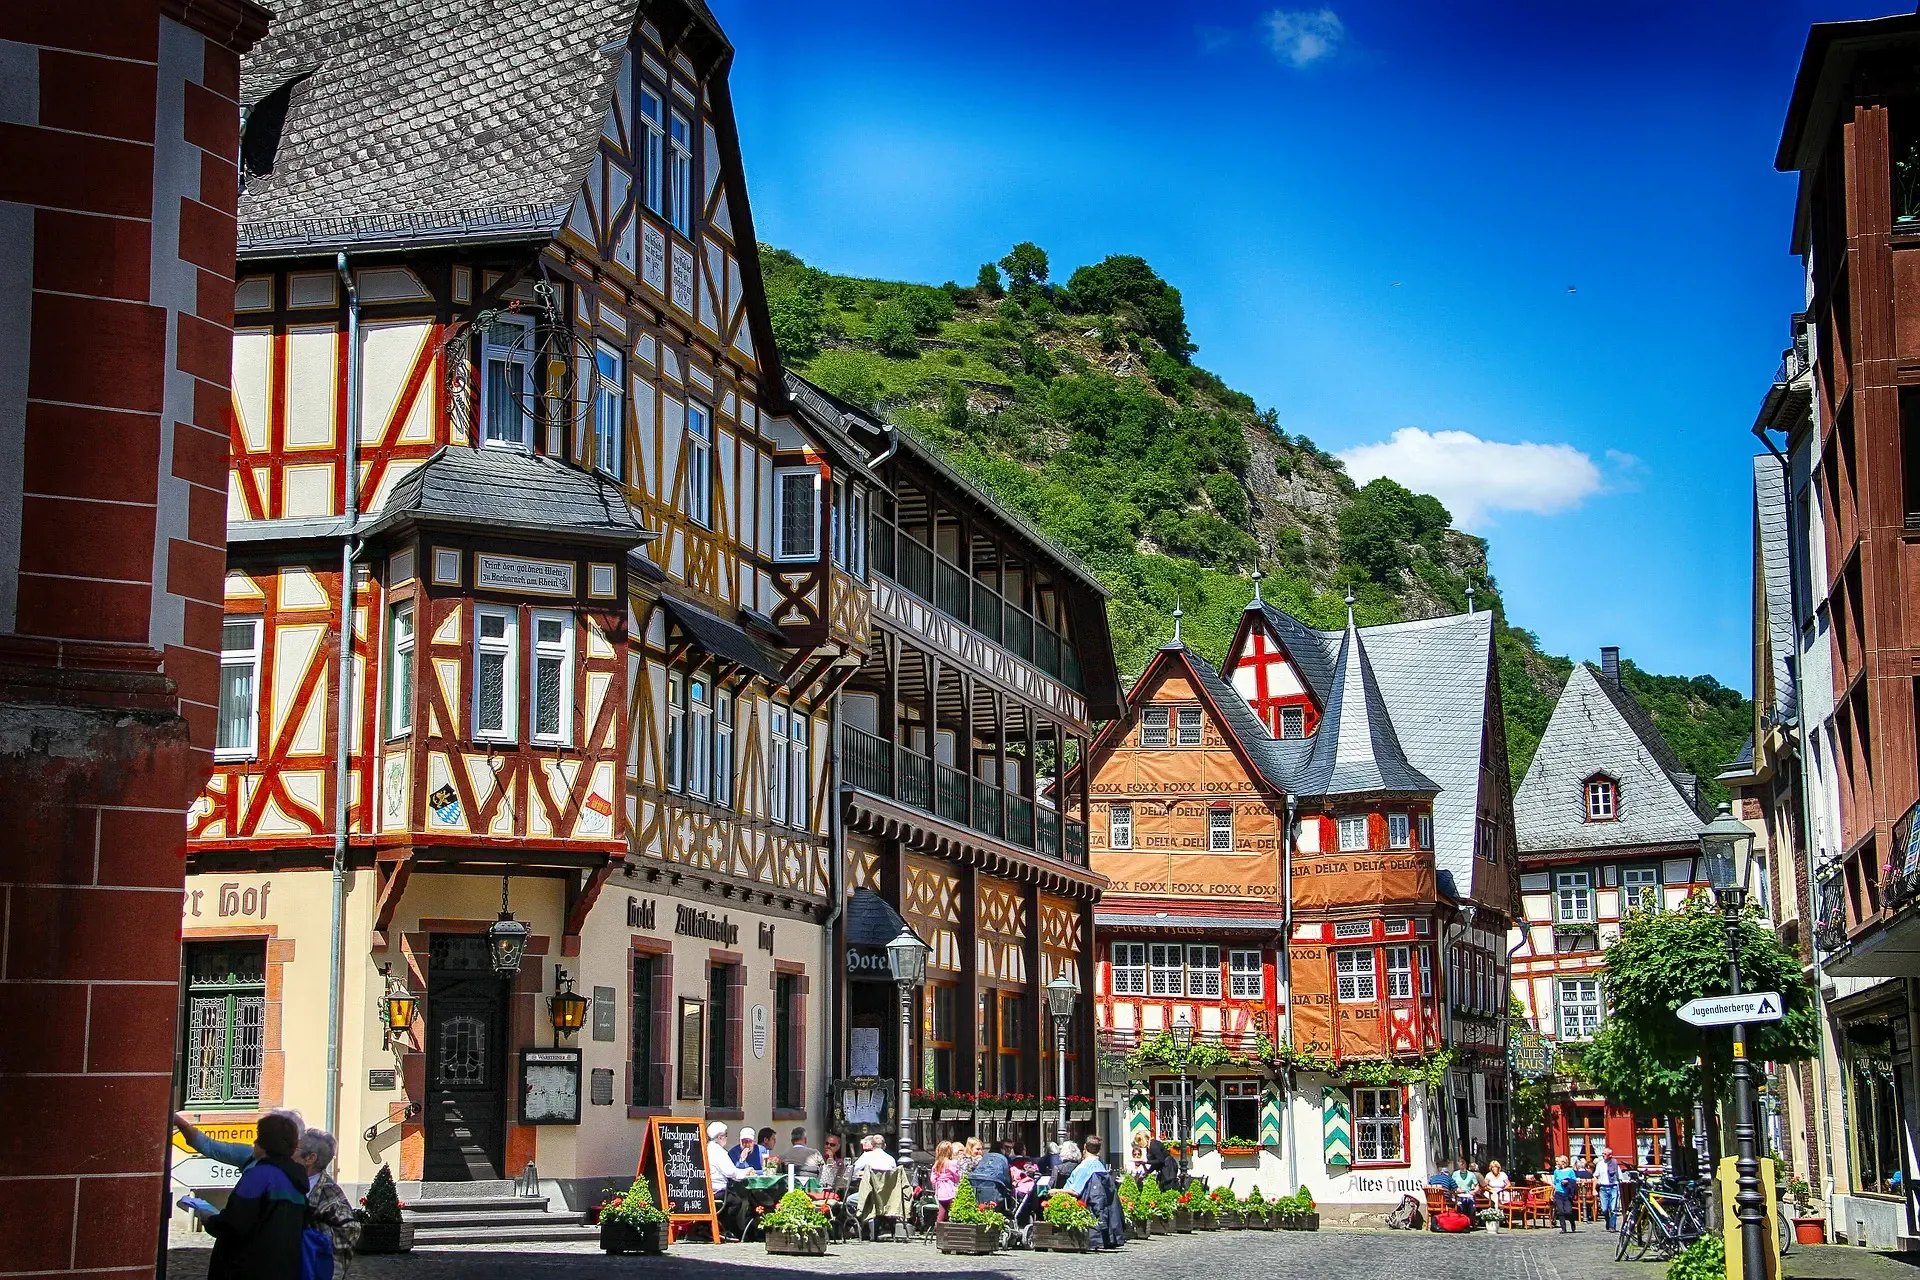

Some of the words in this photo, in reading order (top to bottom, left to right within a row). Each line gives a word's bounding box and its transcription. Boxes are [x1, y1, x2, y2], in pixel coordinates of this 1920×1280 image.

[502, 562, 514, 571] den
[1127, 783, 1158, 792] FOXX
[1164, 783, 1195, 792] FOXX
[1176, 807, 1206, 816] DELTA
[1146, 837, 1178, 846] DELTA
[1315, 862, 1349, 874] DELTA
[1353, 860, 1387, 872] DELTA
[1391, 860, 1417, 870] DELTA
[1134, 882, 1167, 892] FOXX
[1171, 883, 1204, 893] FOXX
[1209, 884, 1242, 894] FOXX
[1247, 885, 1279, 895] FOXX
[219, 881, 271, 920] Hof
[627, 895, 657, 930] Hotel
[758, 921, 776, 957] Hof
[1692, 1003, 1754, 1018] Jugendherberge
[1515, 1048, 1545, 1059] ALTES
[1516, 1059, 1545, 1070] HAUS
[673, 1140, 684, 1149] mit
[1346, 1175, 1383, 1193] Altes
[1387, 1175, 1425, 1194] Haus
